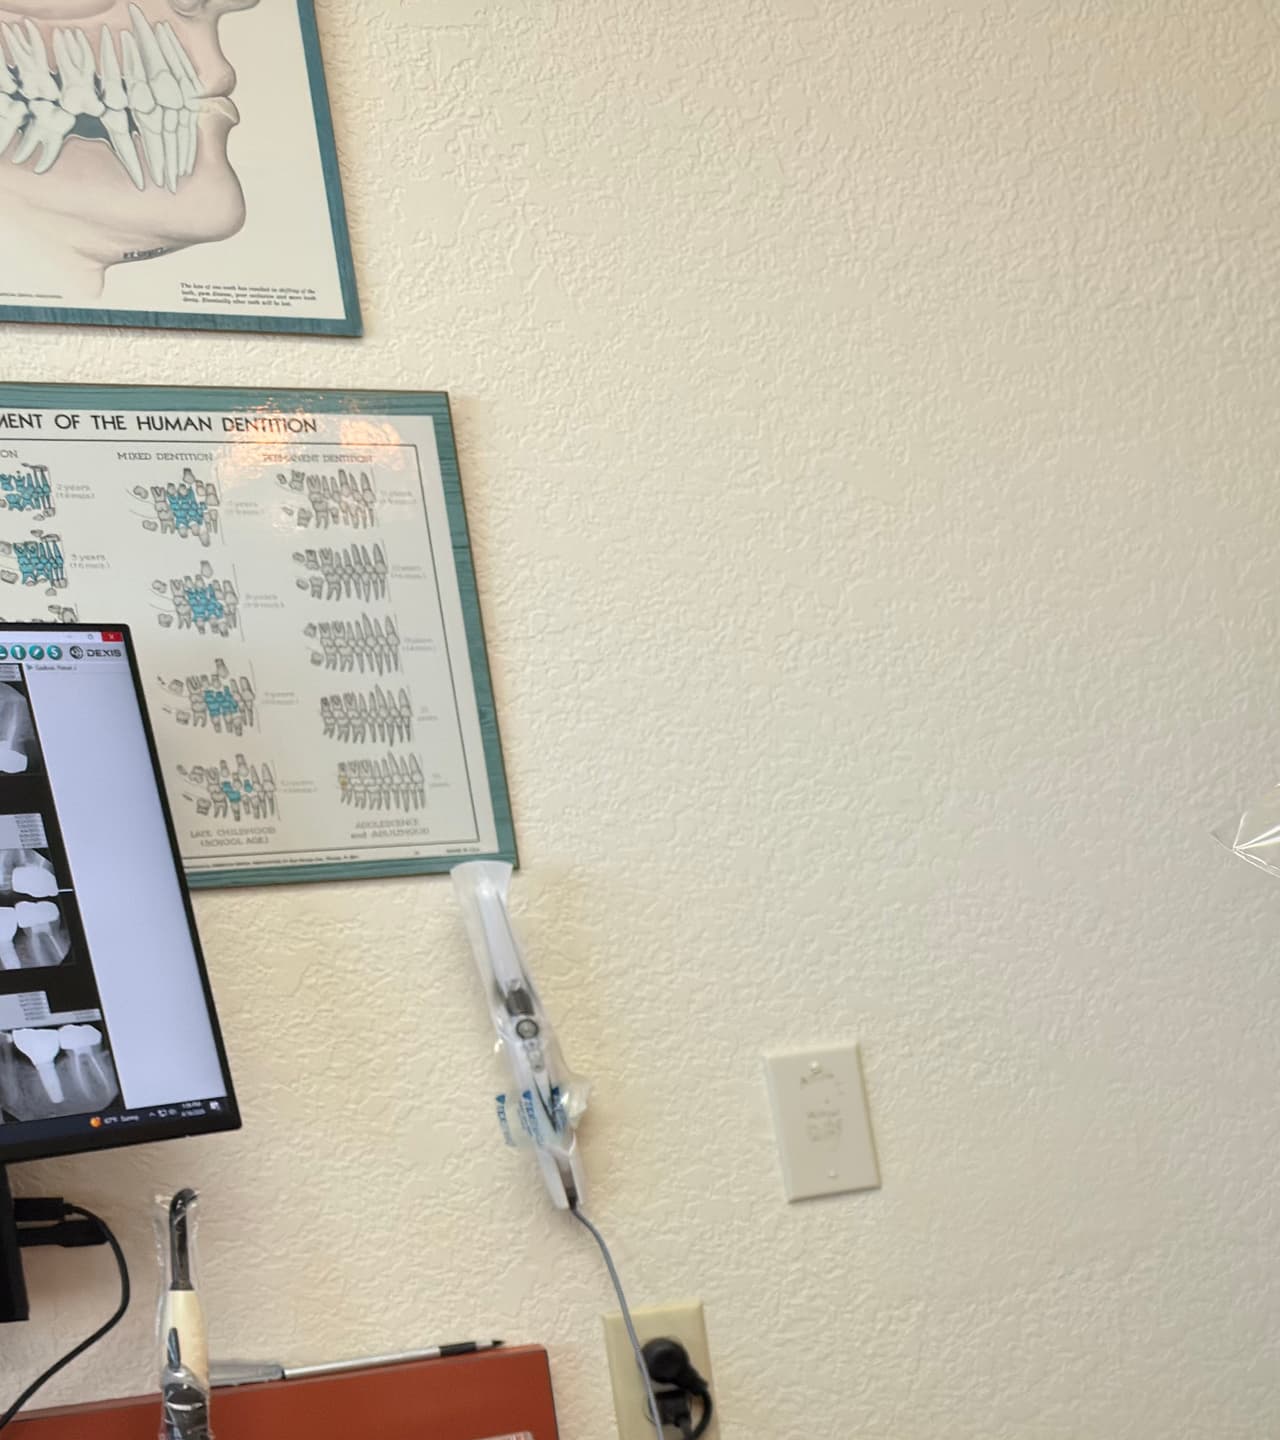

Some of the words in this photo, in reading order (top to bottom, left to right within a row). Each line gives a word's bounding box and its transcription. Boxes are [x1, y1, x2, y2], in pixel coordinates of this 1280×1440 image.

[54, 414, 80, 430] OF
[91, 415, 127, 430] THE
[137, 416, 213, 431] HUMAN
[222, 417, 318, 433] DENTITION
[117, 452, 151, 461] MIXED
[156, 453, 213, 461] DENTITION
[86, 649, 122, 657] DEXIS
